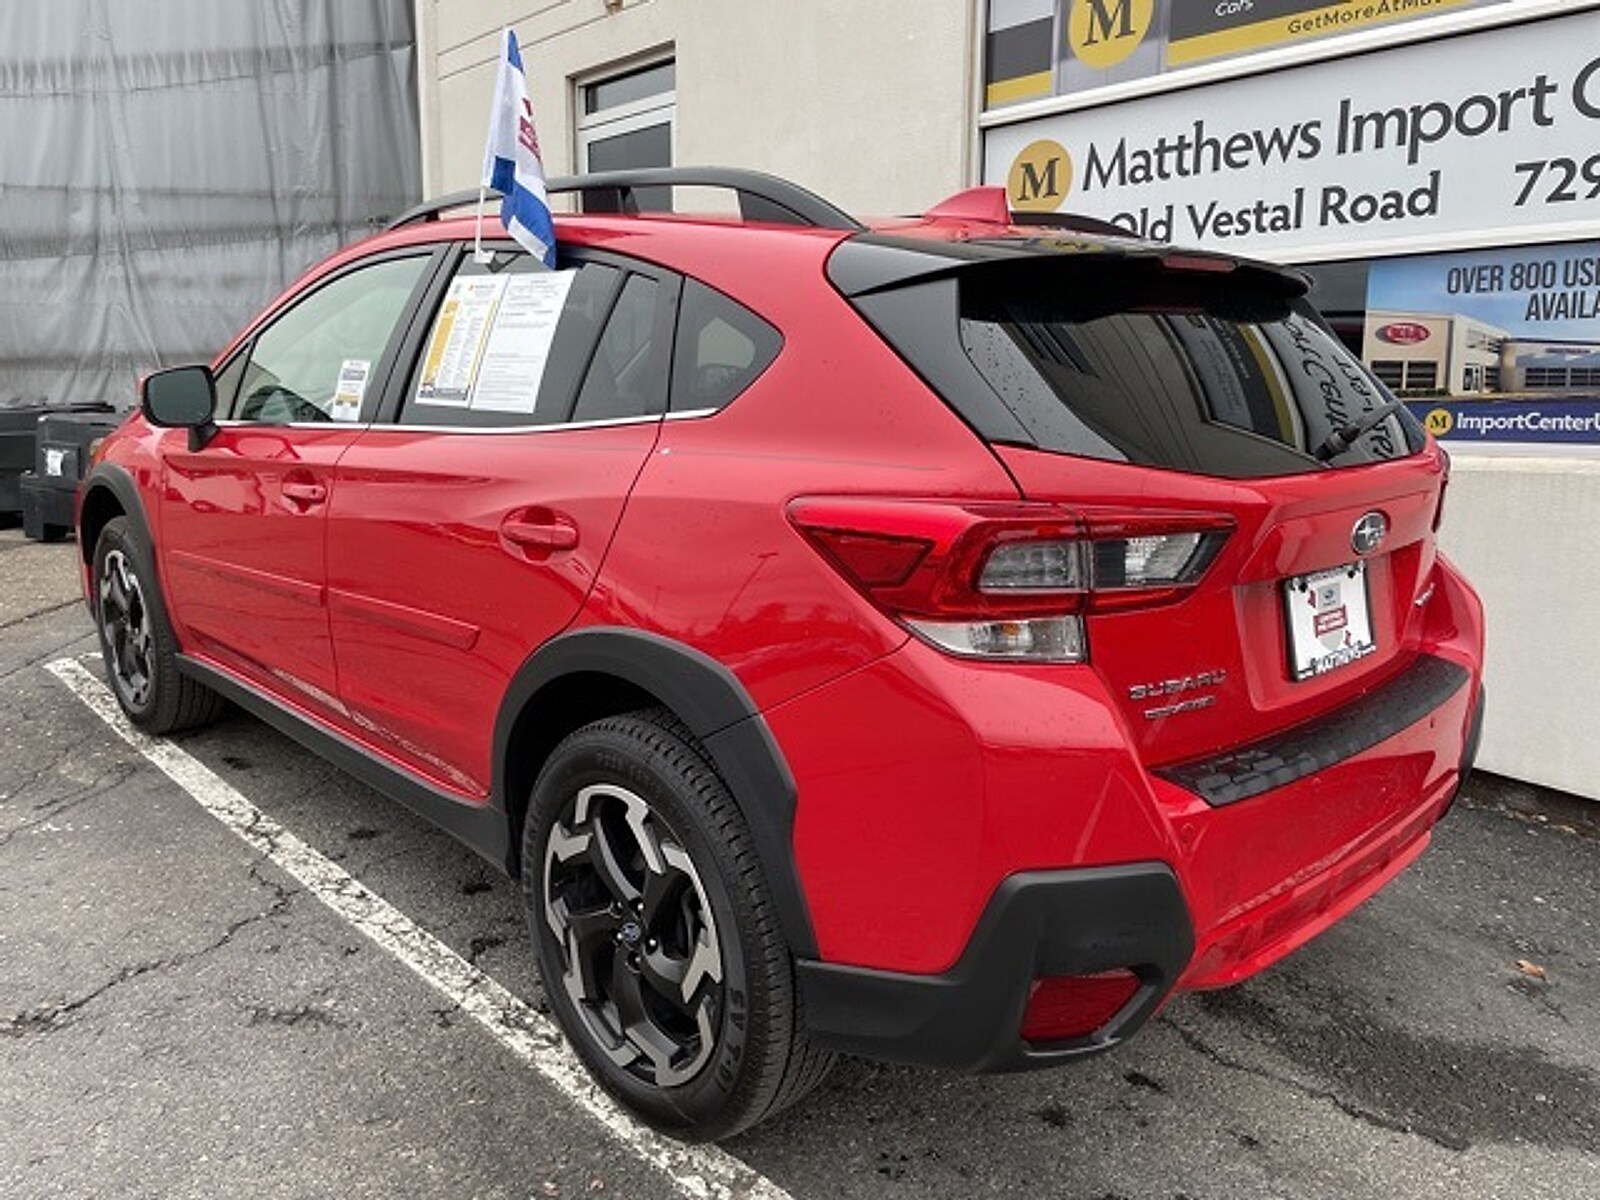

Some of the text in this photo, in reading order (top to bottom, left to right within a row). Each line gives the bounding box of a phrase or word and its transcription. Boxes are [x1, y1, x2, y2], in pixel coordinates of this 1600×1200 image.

[1082, 120, 1322, 191] Matthews
[1337, 75, 1558, 166] Import
[1017, 157, 1060, 201] M
[1187, 187, 1304, 240] Vestal
[1320, 169, 1441, 226] Road
[1447, 265, 1504, 294] OVER
[1510, 260, 1556, 291] 800
[1429, 409, 1448, 429] M
